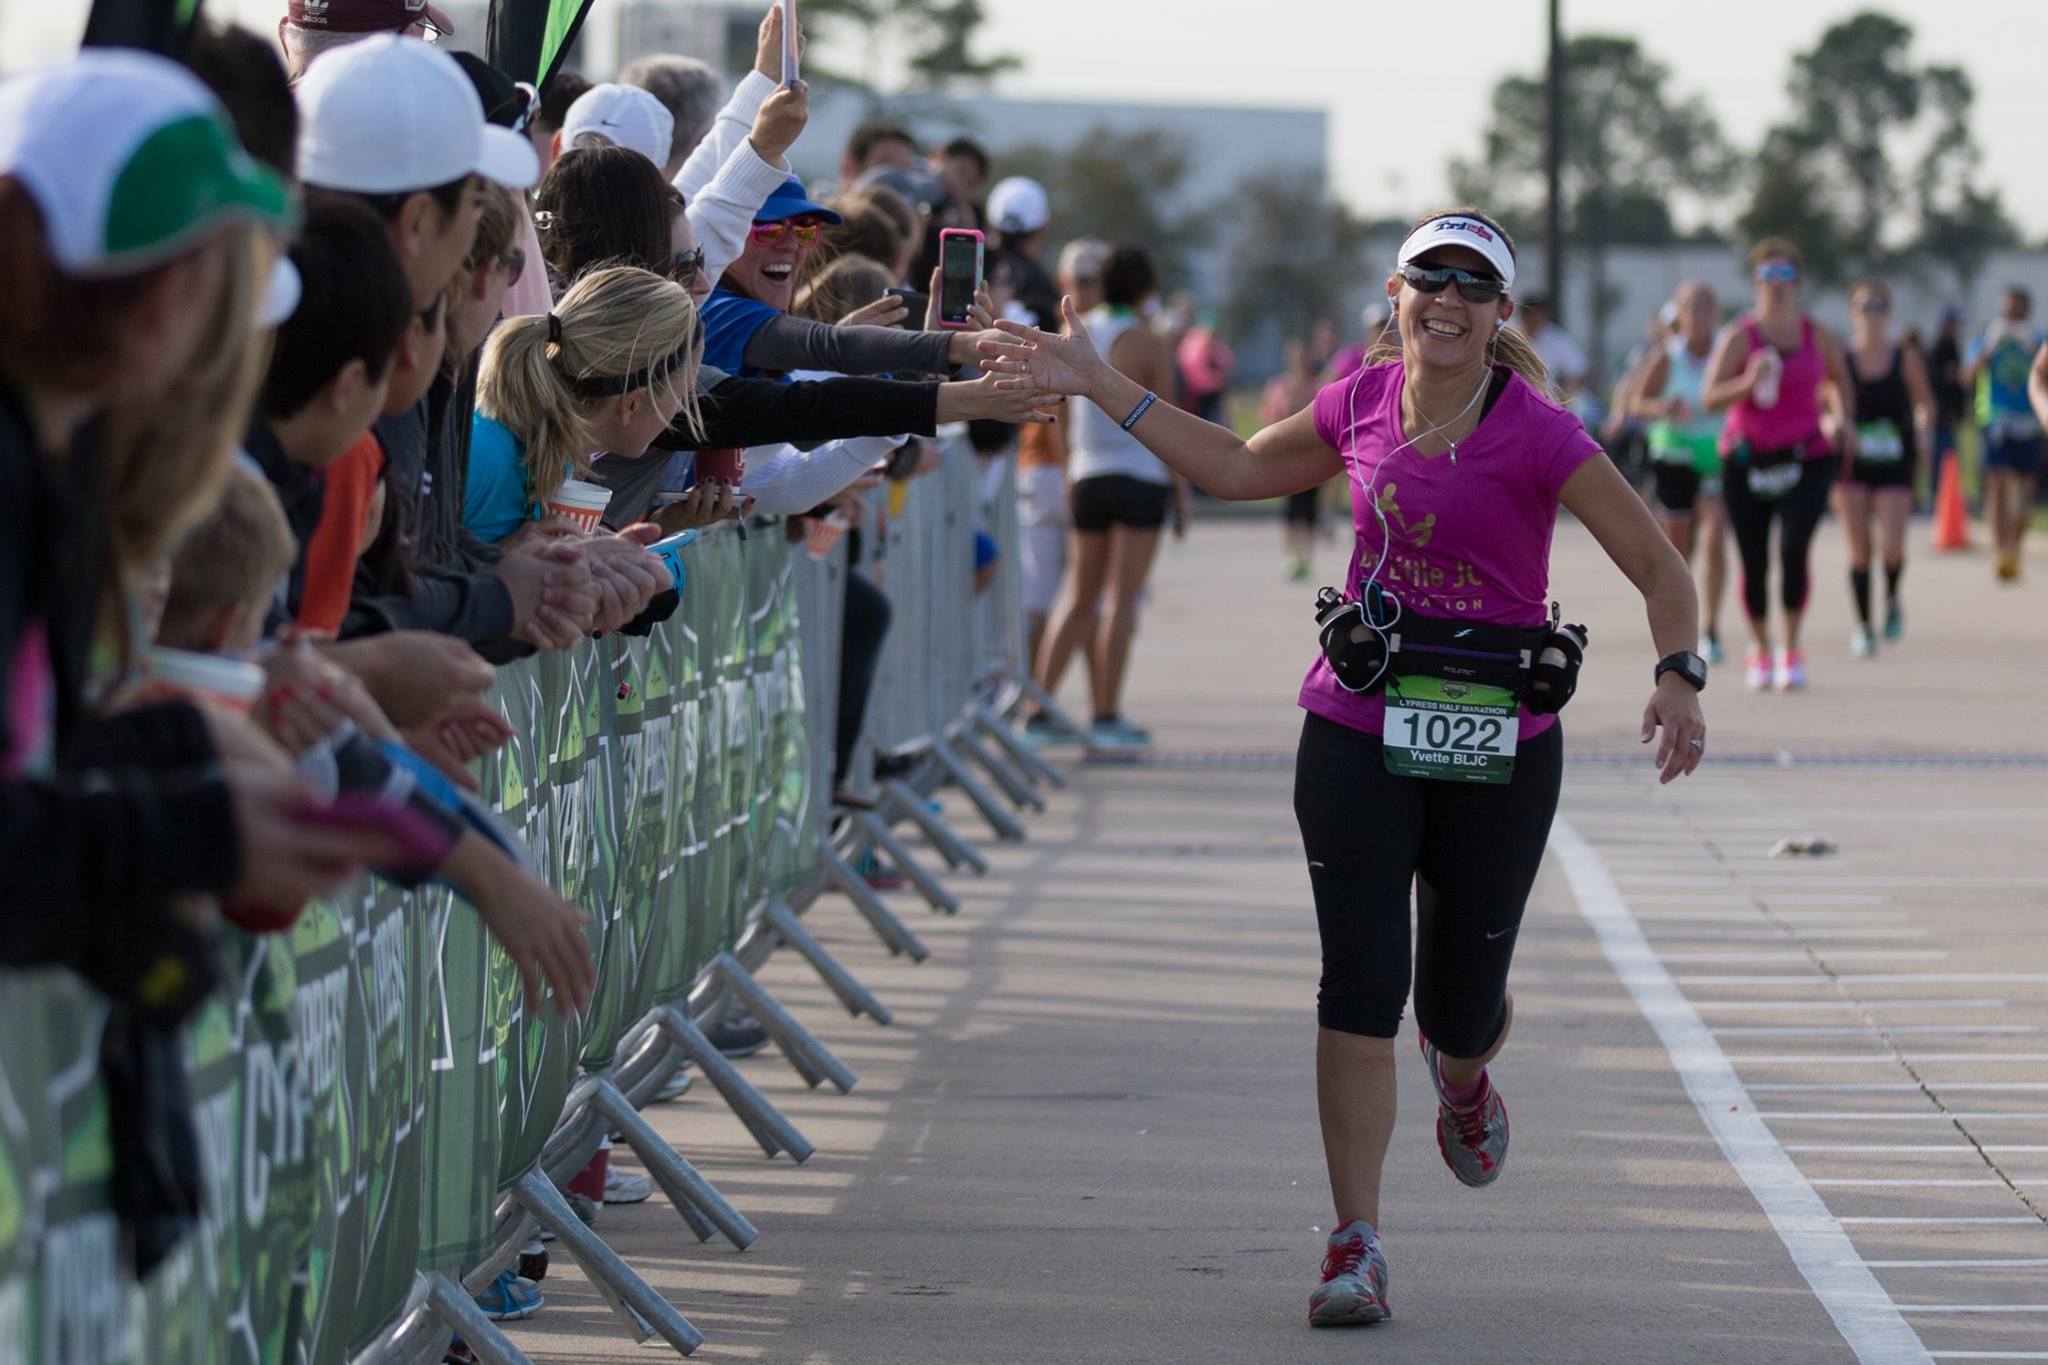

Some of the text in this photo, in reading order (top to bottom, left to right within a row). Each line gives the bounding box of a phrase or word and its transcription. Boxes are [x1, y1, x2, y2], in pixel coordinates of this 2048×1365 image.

[302, 13, 328, 24] adidas
[1439, 703, 1461, 712] HALF
[1462, 705, 1507, 715] MARATHON
[1403, 712, 1502, 753] 1022
[1410, 749, 1488, 767] Yvette BLJC
